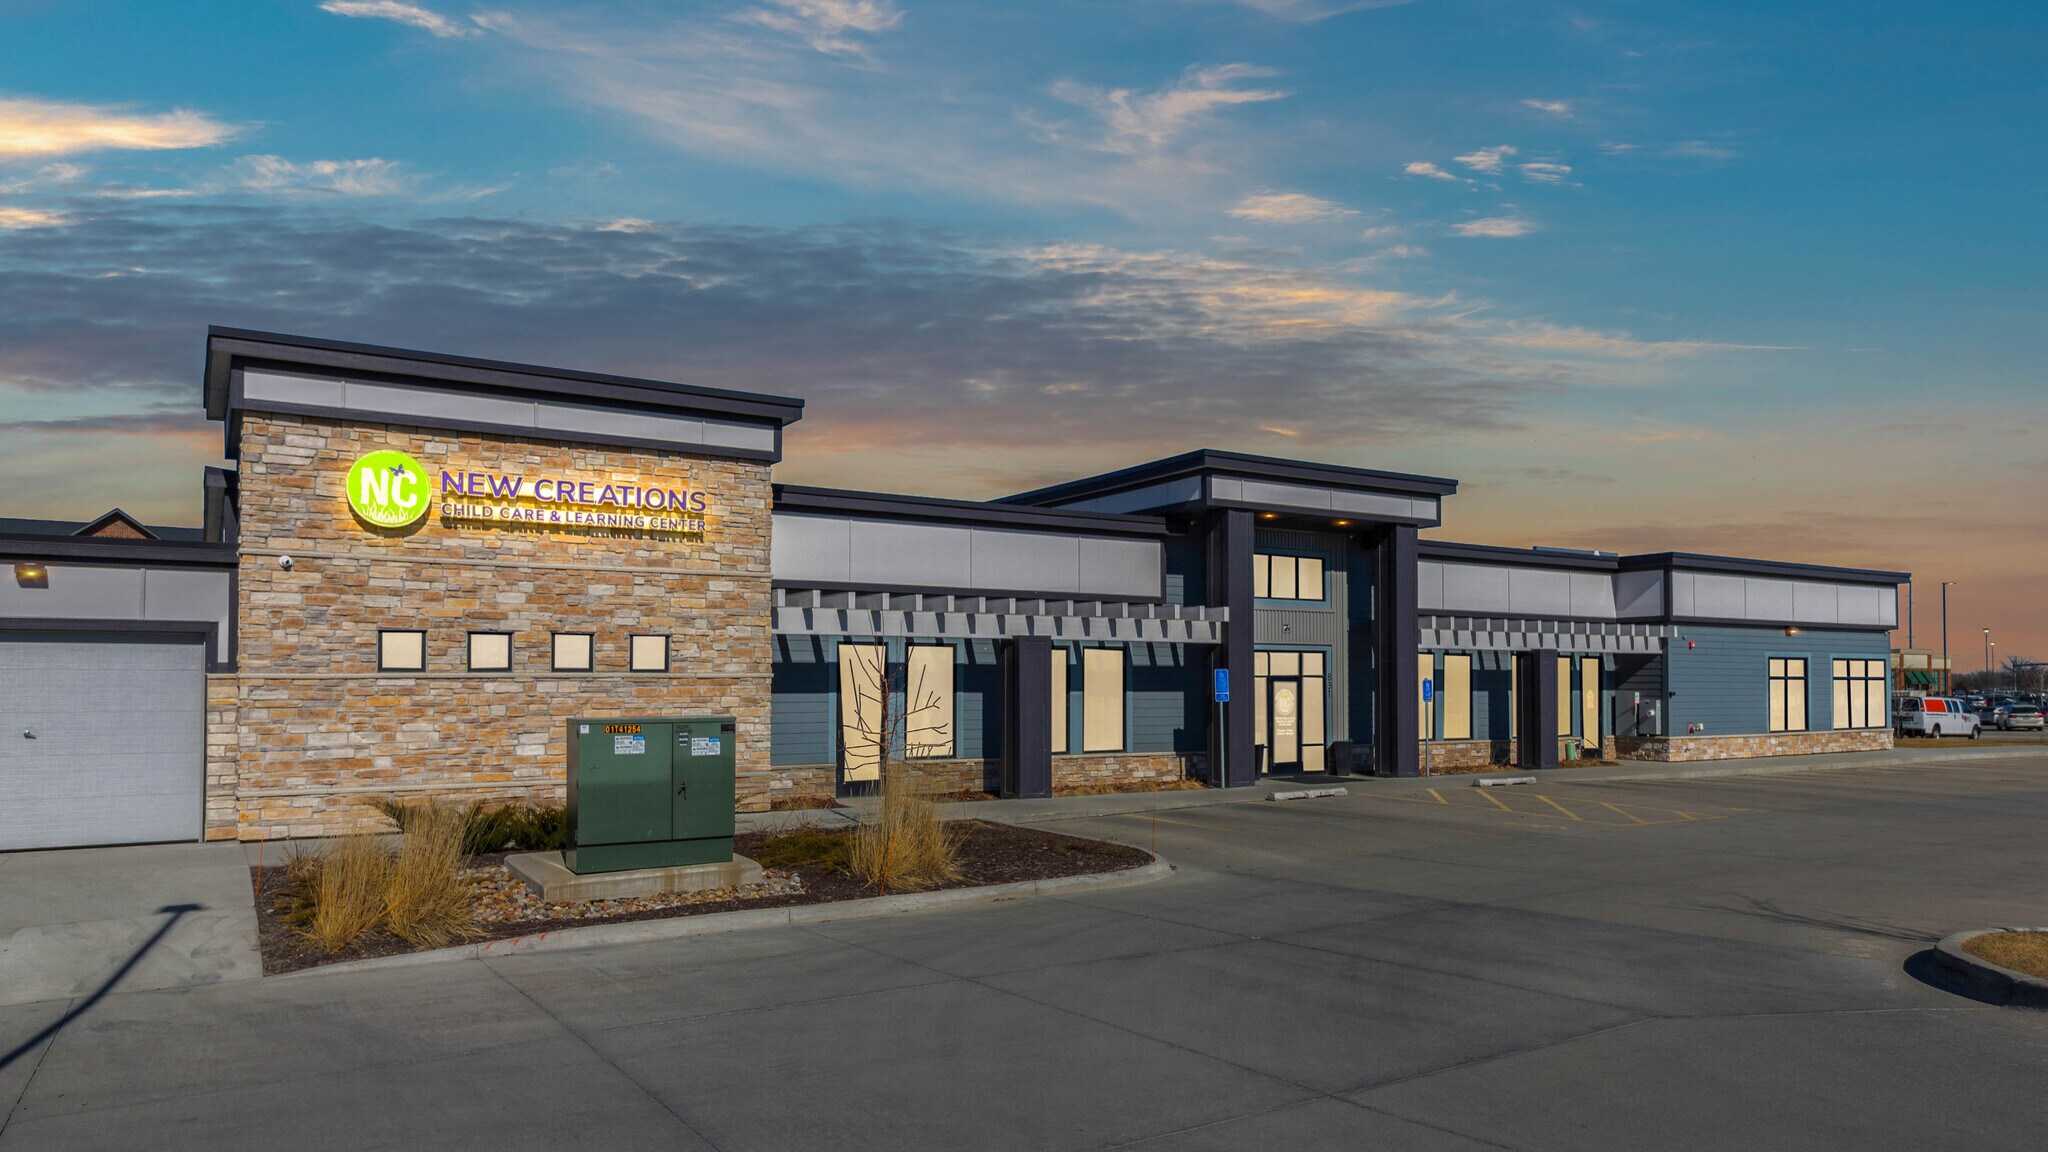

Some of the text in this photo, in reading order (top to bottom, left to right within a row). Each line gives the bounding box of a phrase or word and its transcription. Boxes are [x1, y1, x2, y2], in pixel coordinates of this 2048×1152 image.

[359, 467, 418, 508] NC
[441, 470, 707, 513] NEW CREATIONS
[441, 503, 706, 531] CHILD CARE & LEARNING CENTER
[605, 725, 641, 733] 01T41254
